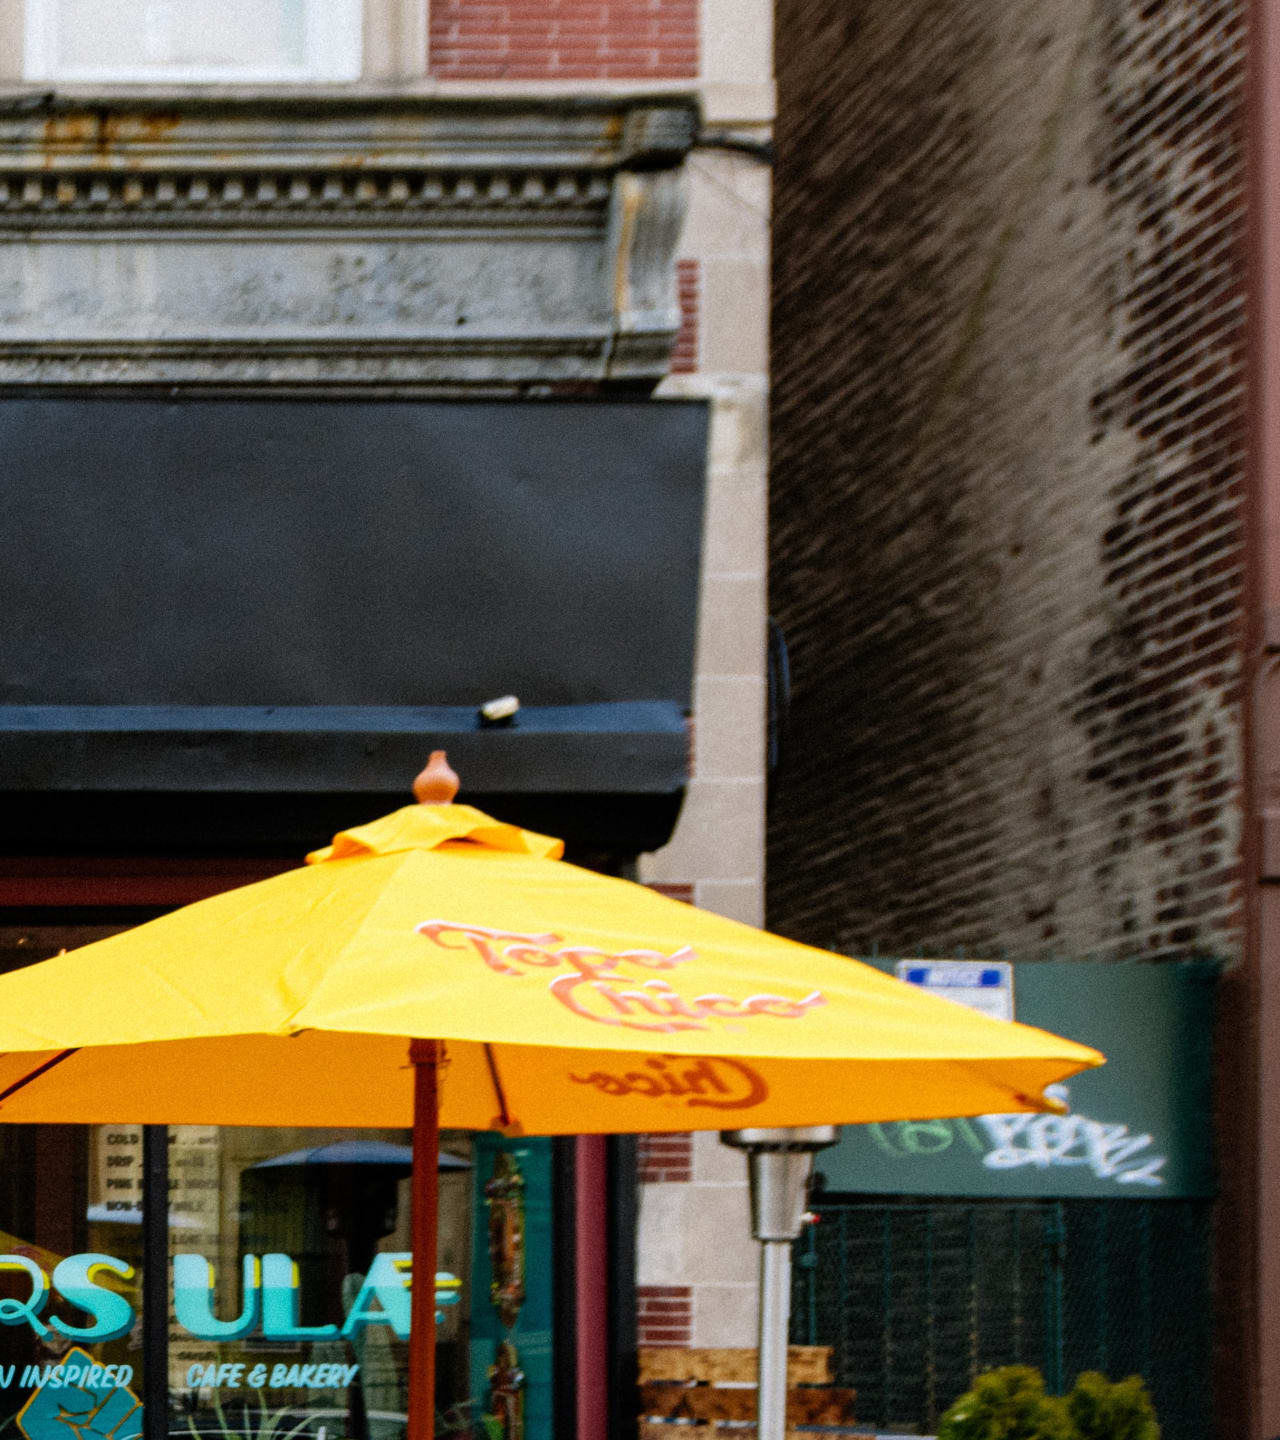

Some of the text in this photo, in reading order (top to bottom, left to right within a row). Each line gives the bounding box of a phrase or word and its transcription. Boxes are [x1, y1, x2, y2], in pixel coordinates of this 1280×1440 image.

[19, 1364, 134, 1389] INSPIRED
[186, 1363, 360, 1389] CAFE & BAKERY
